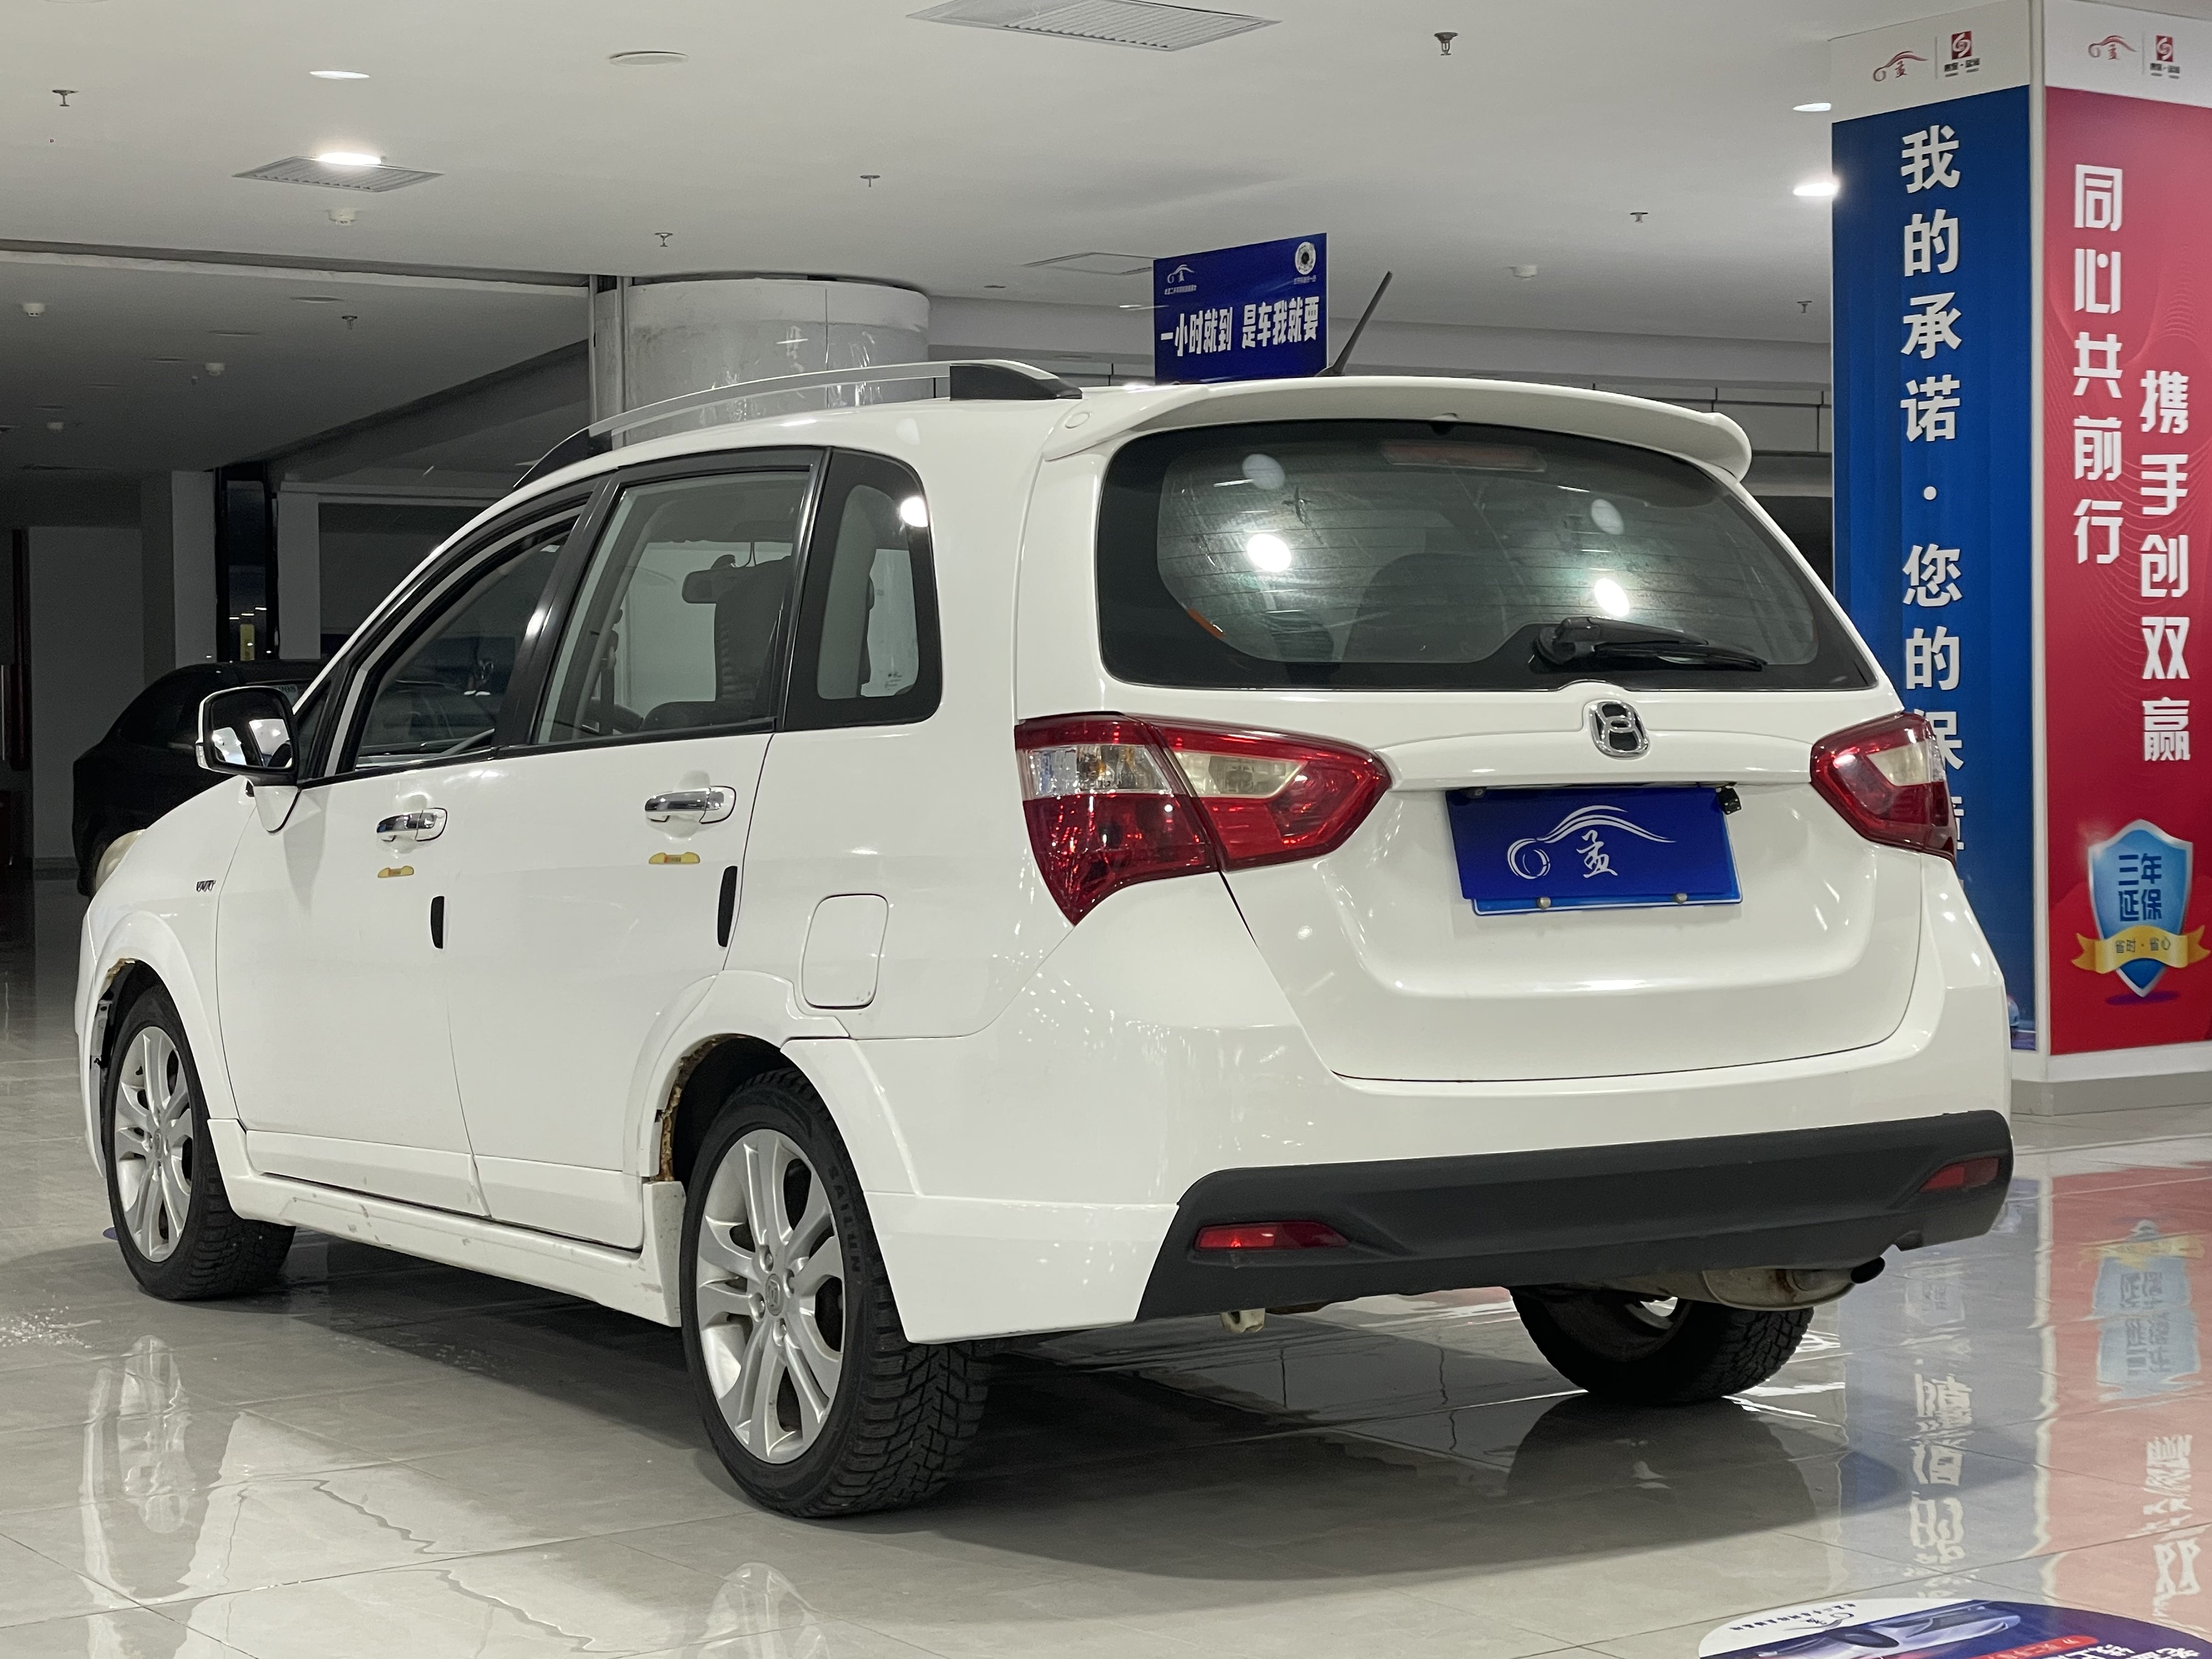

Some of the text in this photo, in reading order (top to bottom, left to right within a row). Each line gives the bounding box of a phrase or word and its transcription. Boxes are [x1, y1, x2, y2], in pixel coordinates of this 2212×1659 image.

[1161, 296, 1319, 357] 一小时就到 是车我就要
[2073, 164, 2123, 564] 同心共前行
[1900, 125, 1964, 850] 我的承诺·您的保
[2140, 370, 2190, 761] 携手创双赢
[2118, 853, 2162, 884] 三年
[2118, 889, 2162, 922] 延保
